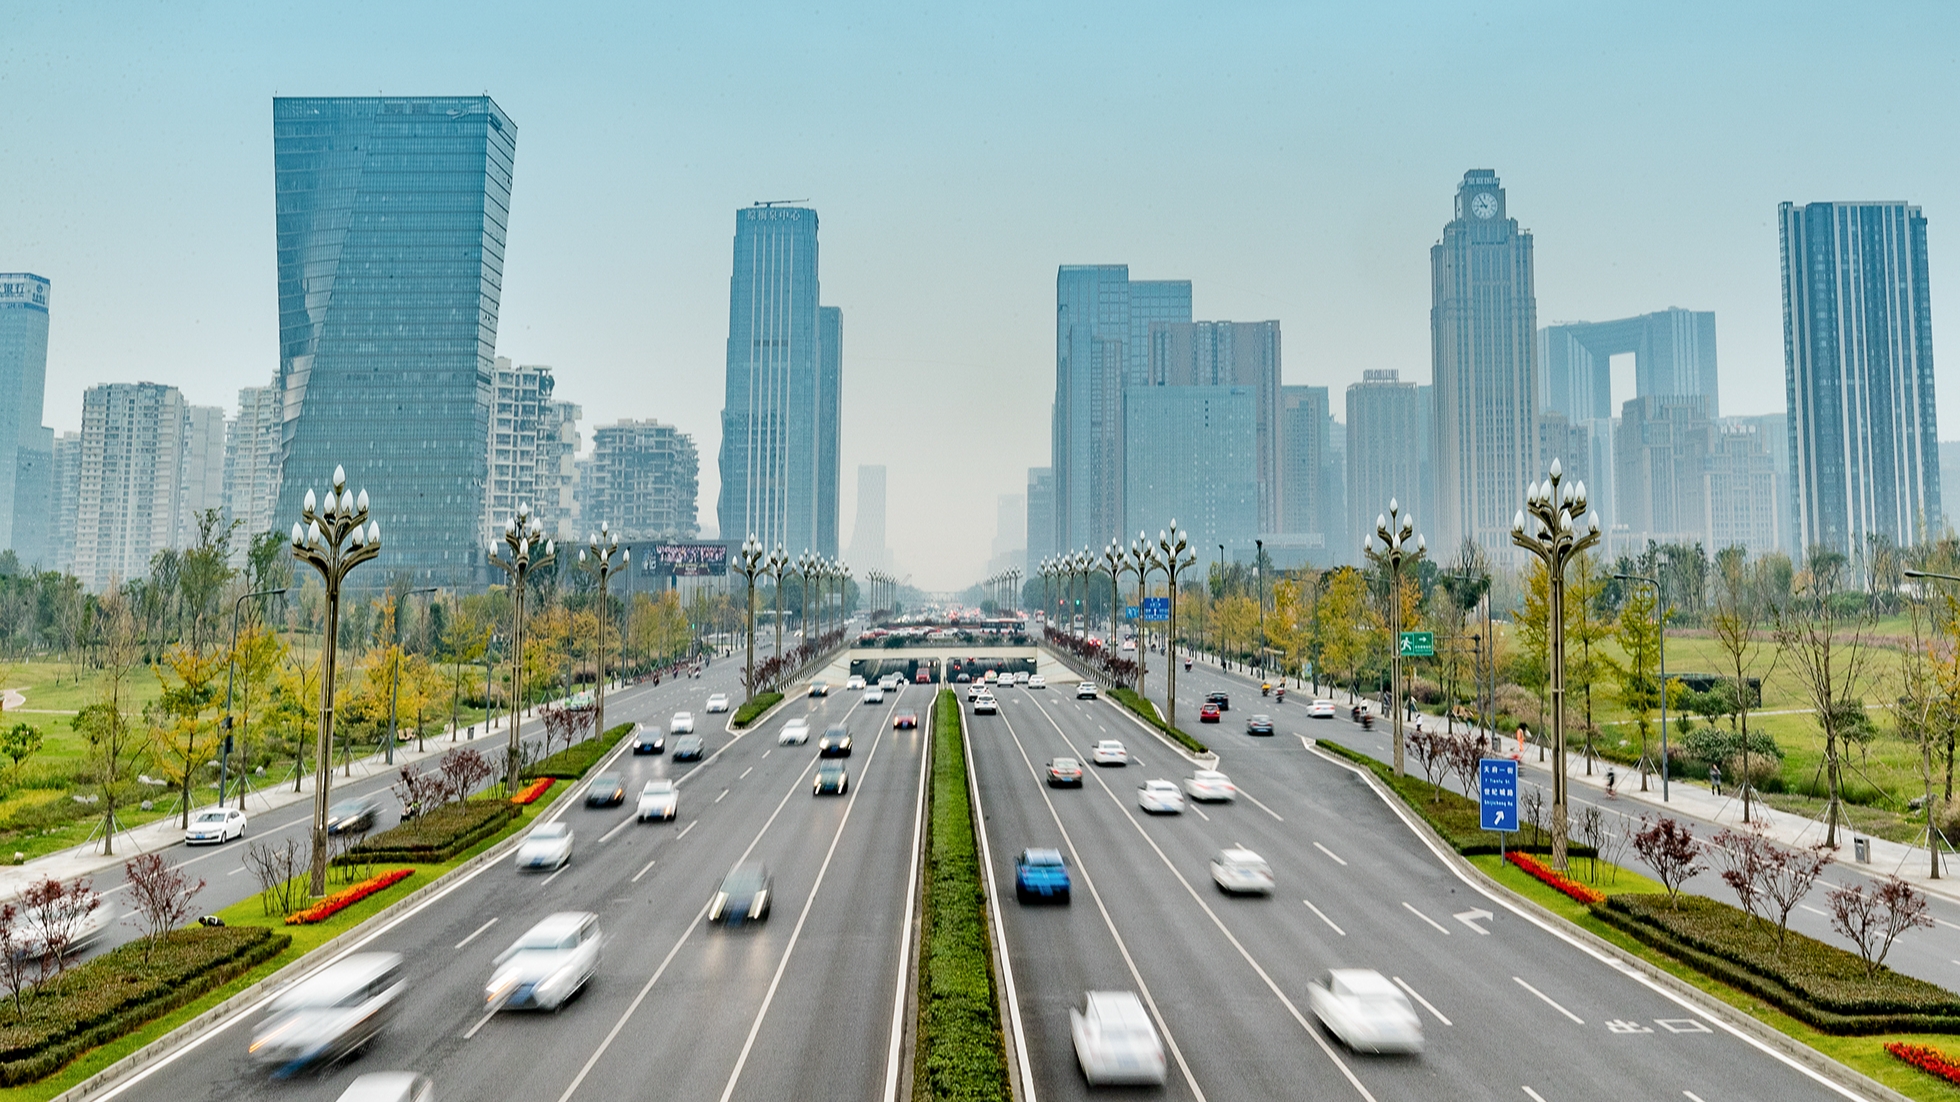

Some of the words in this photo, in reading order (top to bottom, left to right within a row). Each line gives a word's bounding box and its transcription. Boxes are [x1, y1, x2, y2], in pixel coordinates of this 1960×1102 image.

[1484, 765, 1514, 775] 天府一街
[1484, 787, 1514, 797] 世纪城路
[1604, 1018, 1714, 1034] 出口
